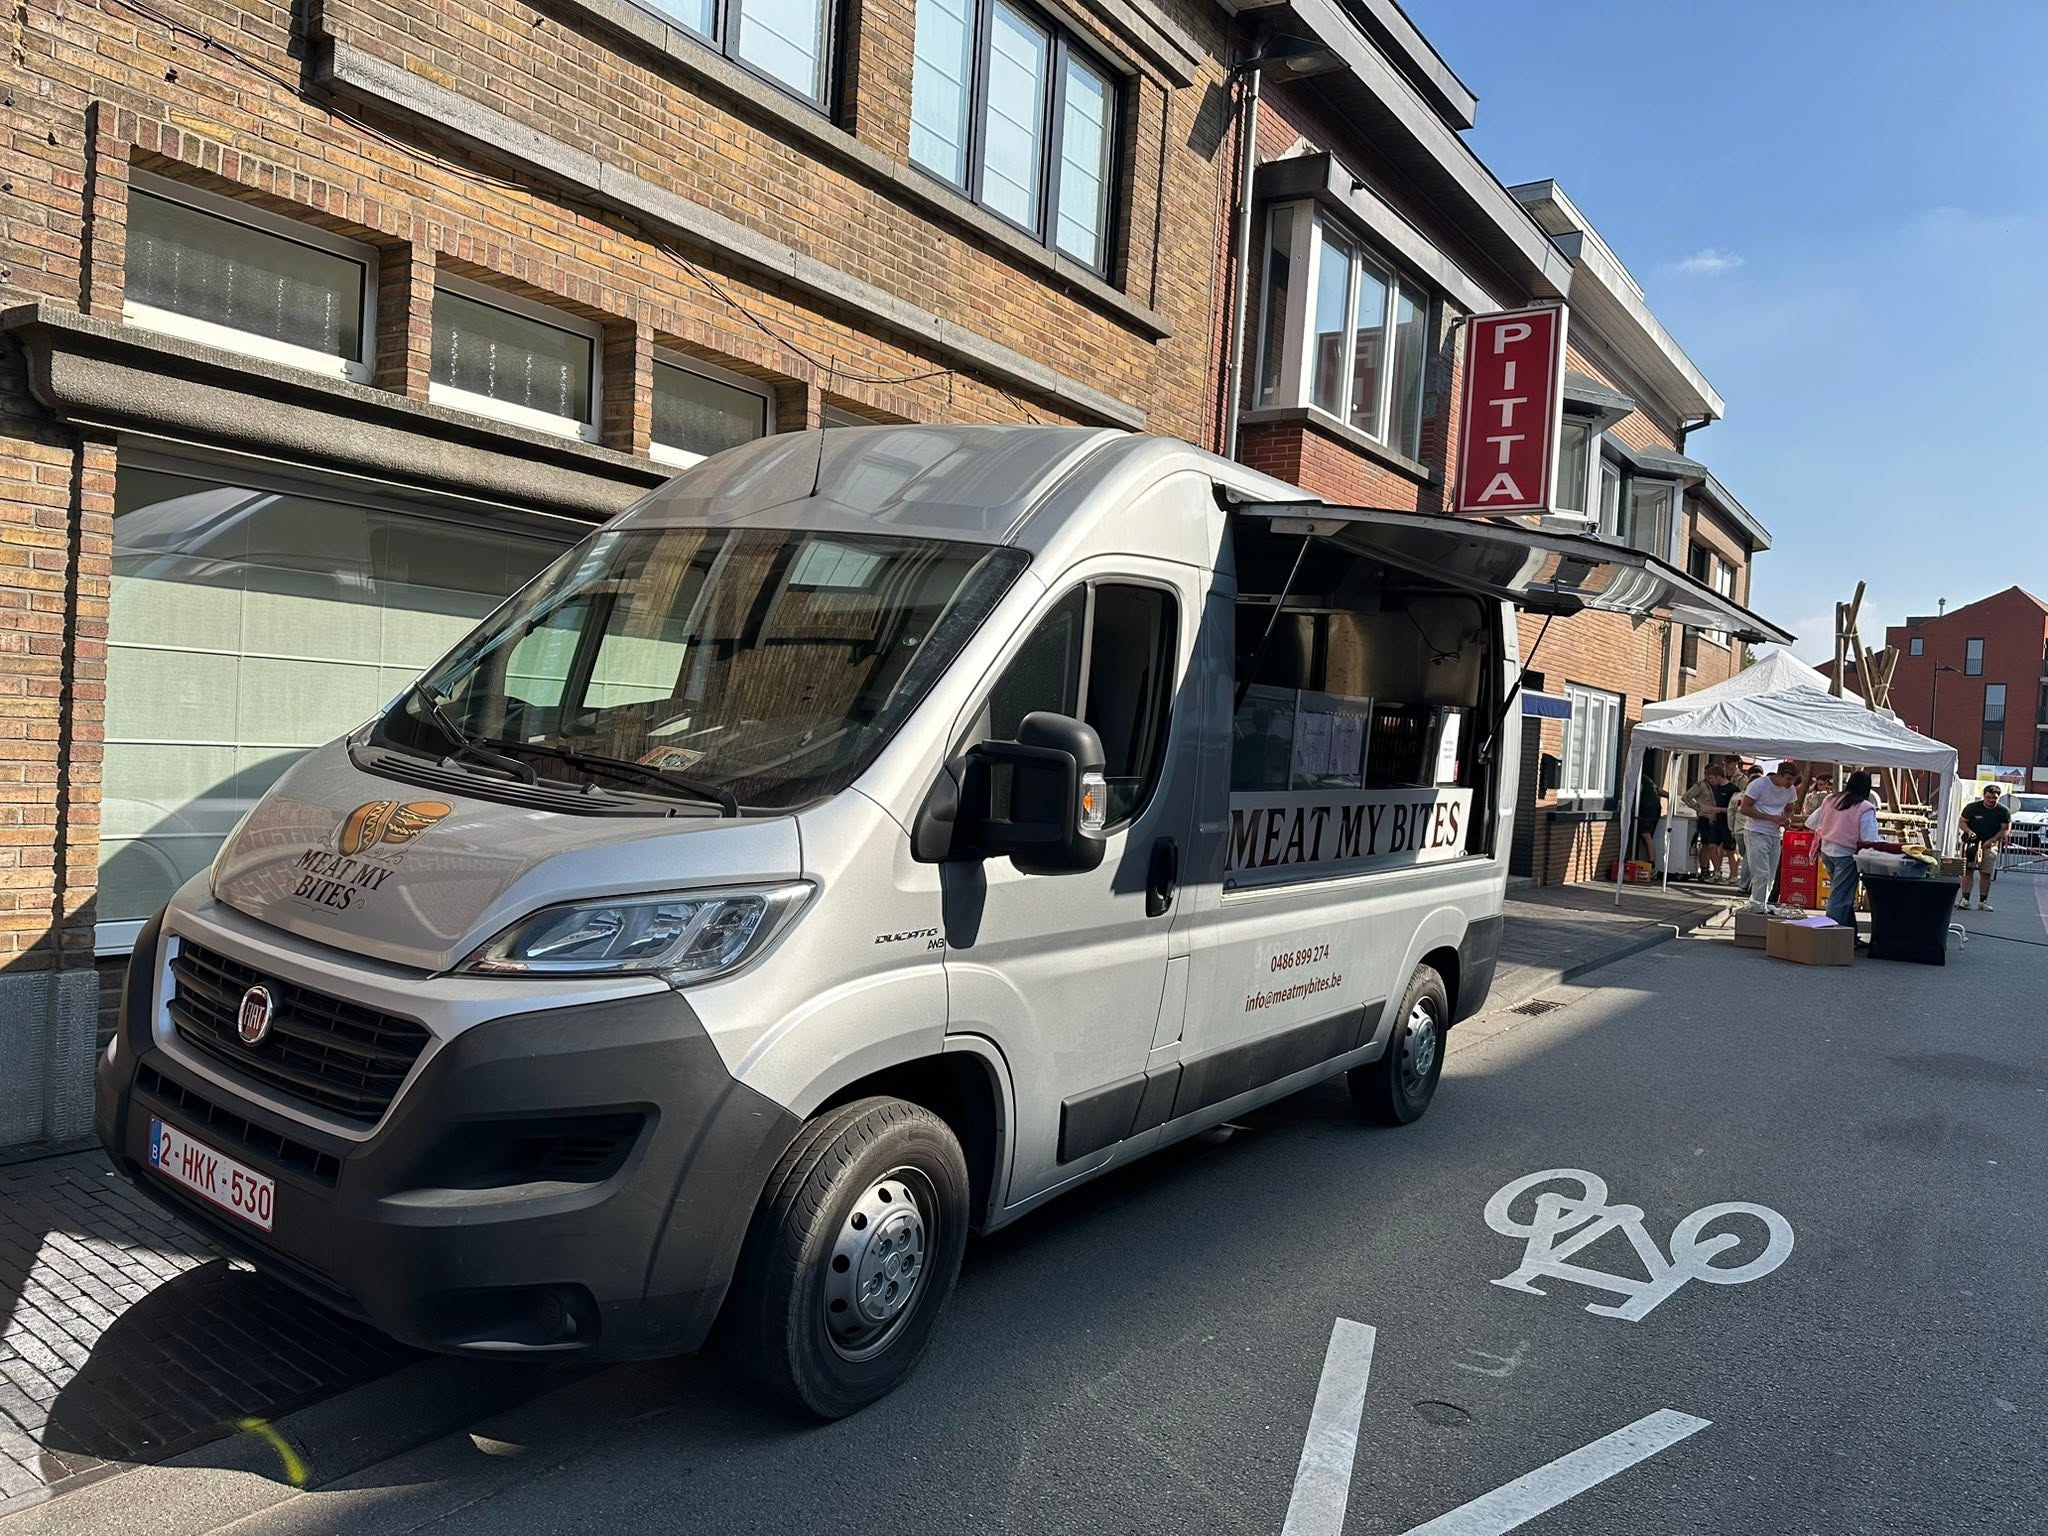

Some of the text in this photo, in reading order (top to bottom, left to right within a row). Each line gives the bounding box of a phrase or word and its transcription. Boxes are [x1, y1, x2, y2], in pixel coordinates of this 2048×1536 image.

[1476, 322, 1532, 502] PITTA
[1224, 801, 1461, 871] MEAT MY BITES
[294, 848, 395, 891] MEAT MY
[293, 875, 357, 910] BITES
[875, 928, 938, 944] DUCATO
[1271, 944, 1329, 972] 0486 899 274
[1245, 972, 1342, 1012] info@meatmybites.be
[243, 1002, 266, 1030] FIAT
[152, 1144, 158, 1159] B
